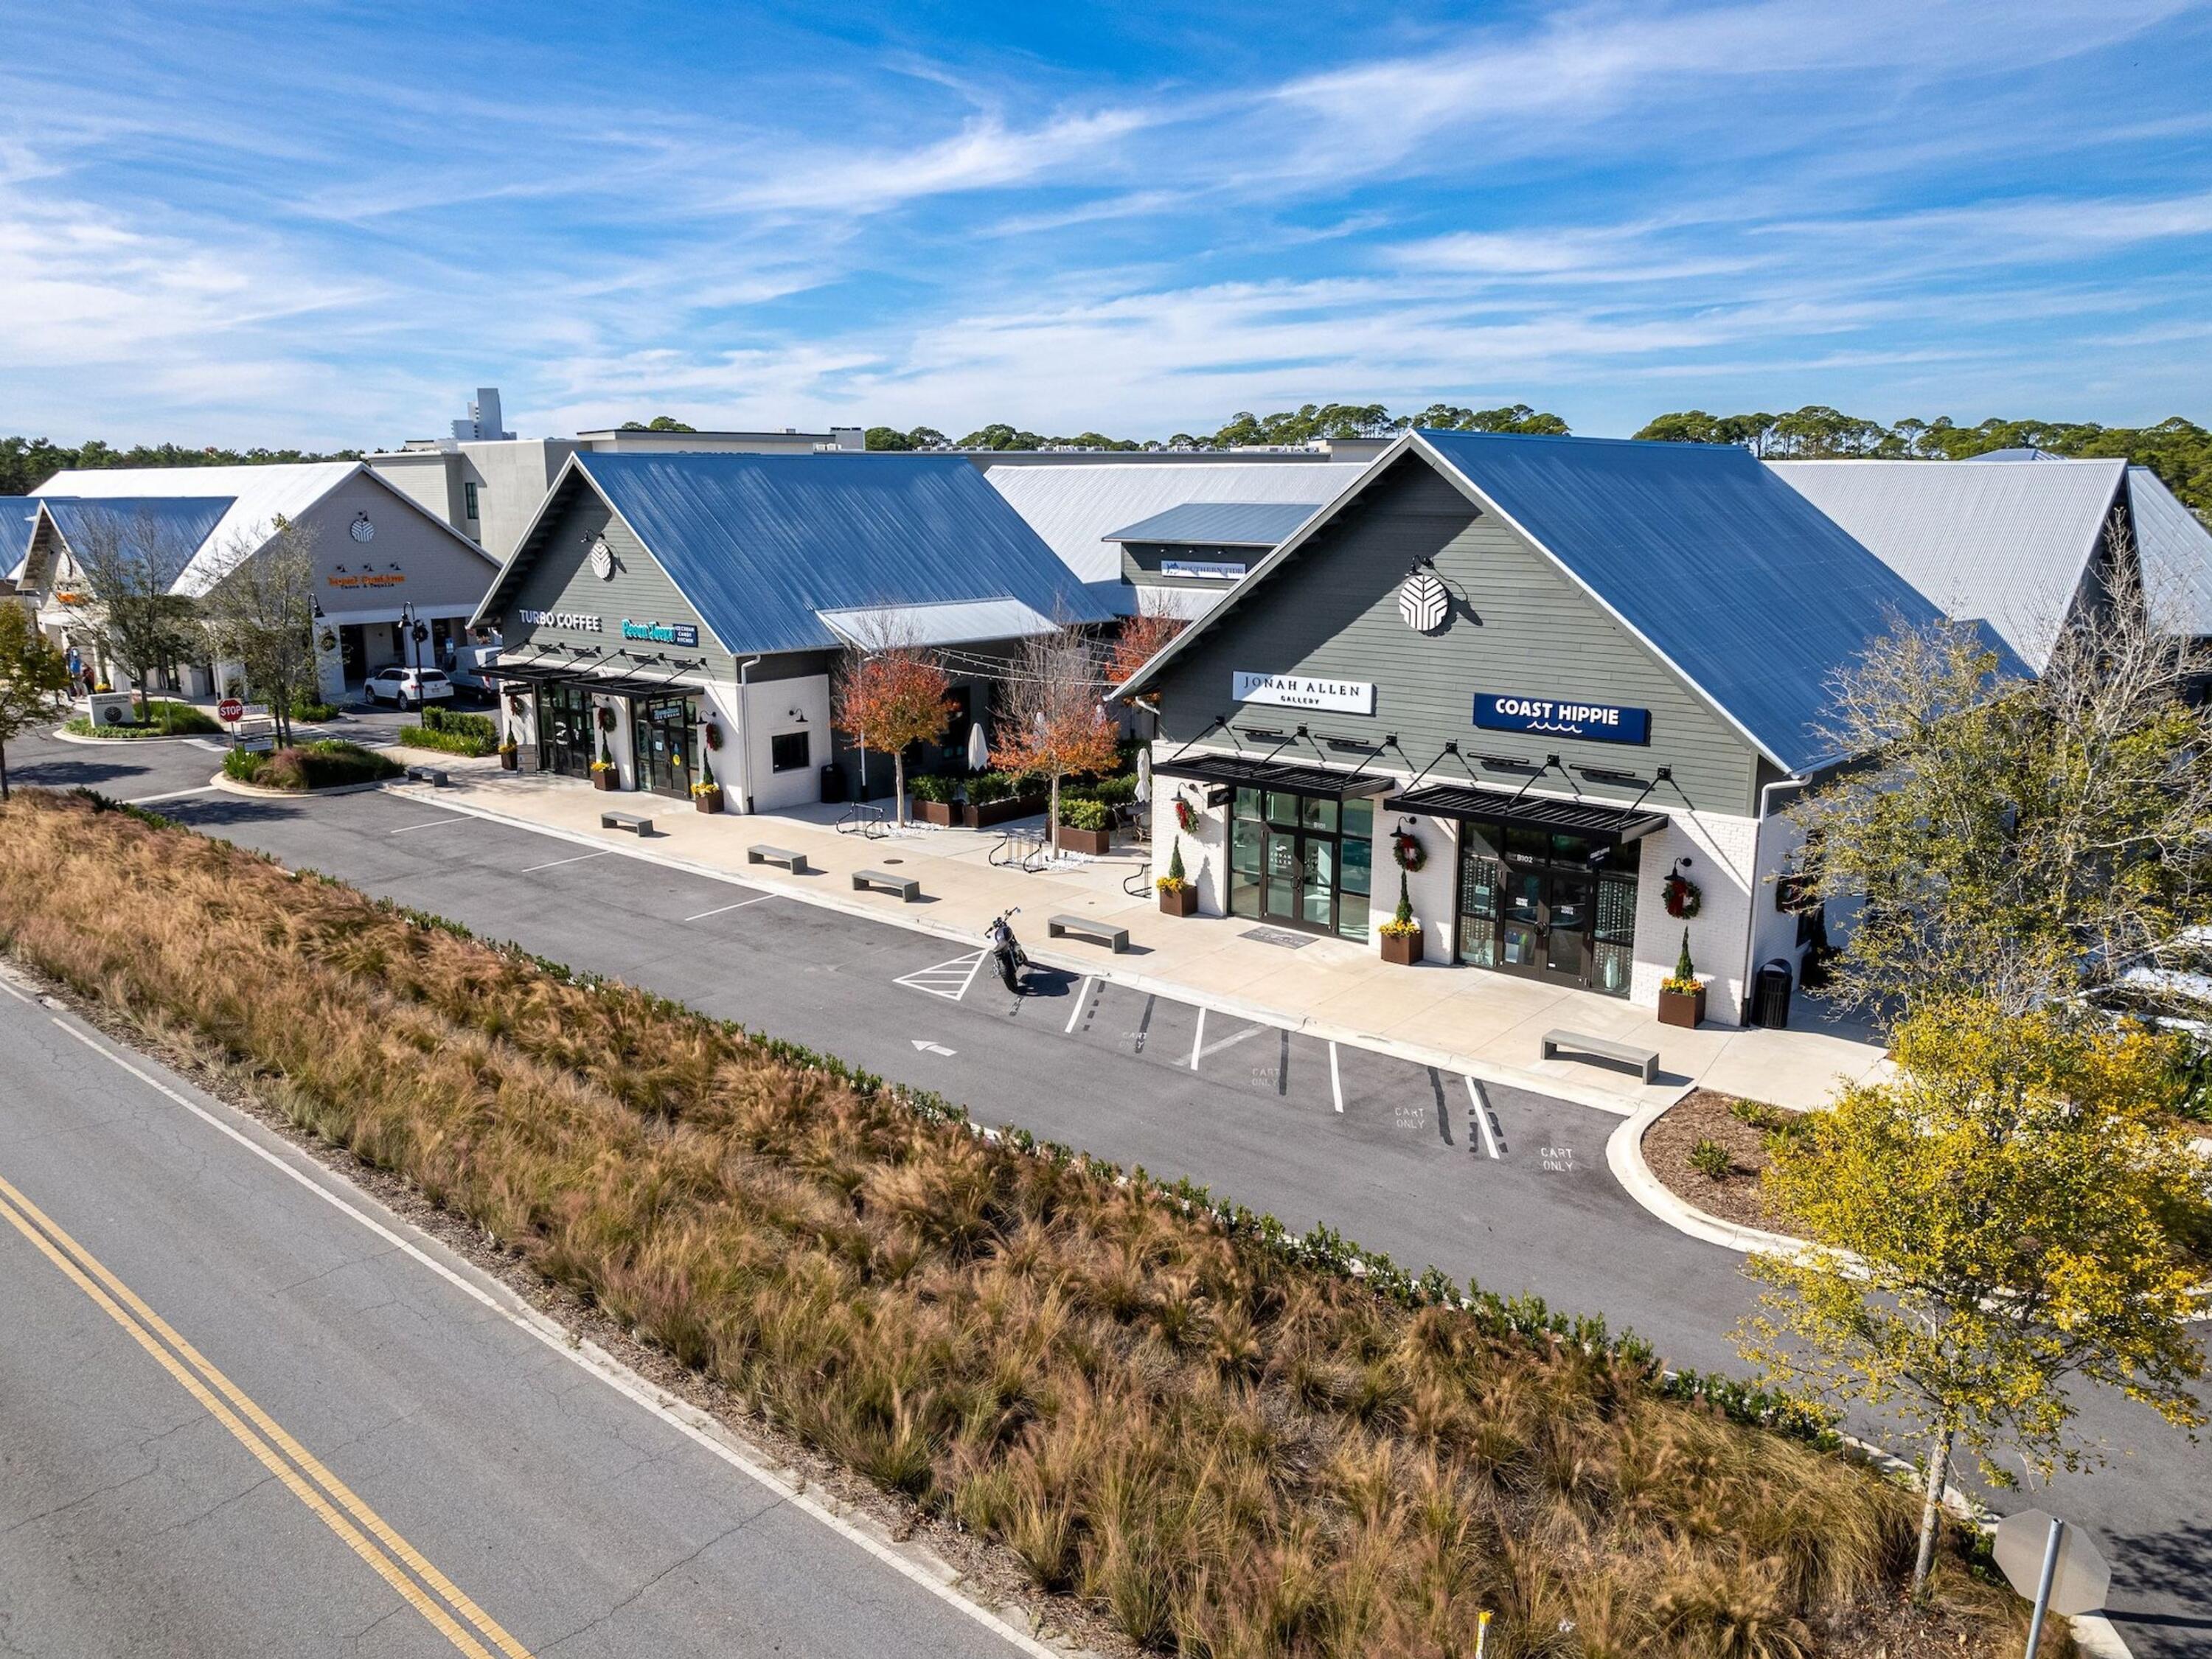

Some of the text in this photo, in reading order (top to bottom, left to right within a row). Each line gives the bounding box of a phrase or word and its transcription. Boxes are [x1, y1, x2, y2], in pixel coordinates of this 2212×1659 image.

[519, 609, 599, 630] TURBO COFFEE
[1244, 676, 1360, 697] JONAH ALLEN
[1281, 695, 1319, 704] GALLERY
[220, 706, 241, 717] STOP
[1495, 698, 1619, 725] COAST HIPPIE
[1517, 854, 1533, 863] B102
[1253, 1068, 1279, 1077] CART
[1252, 1078, 1278, 1086] ONLY
[1395, 1107, 1424, 1117] CART
[1397, 1119, 1425, 1129] ONLY
[1541, 1147, 1572, 1158] CART
[1543, 1160, 1573, 1172] ONLY
